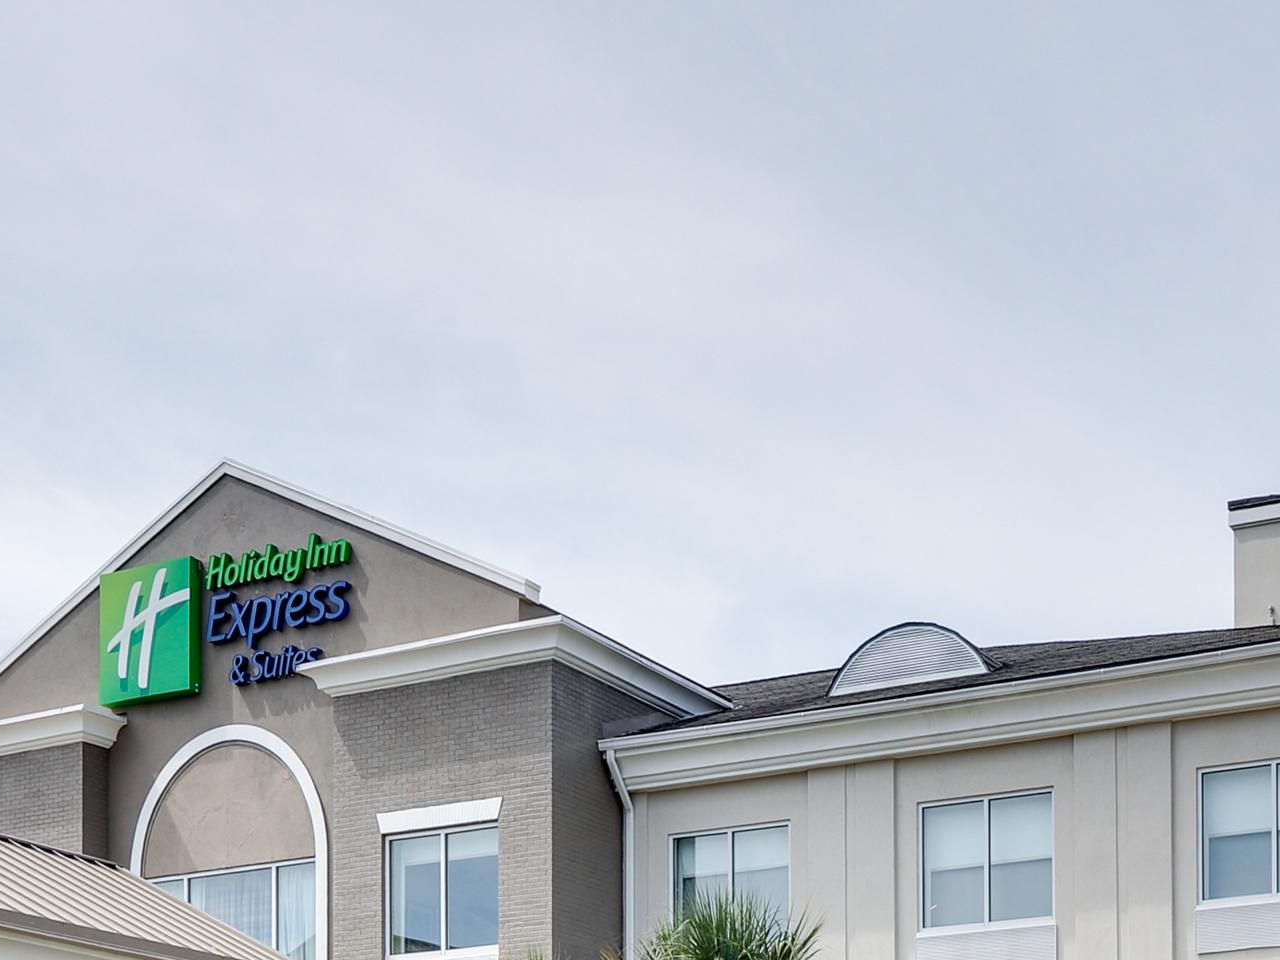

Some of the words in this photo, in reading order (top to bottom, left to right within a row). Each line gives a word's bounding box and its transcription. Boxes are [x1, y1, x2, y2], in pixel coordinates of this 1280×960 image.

[204, 543, 307, 591] Holiday
[306, 532, 352, 571] Inn
[206, 580, 352, 648] Express
[229, 654, 249, 685] &
